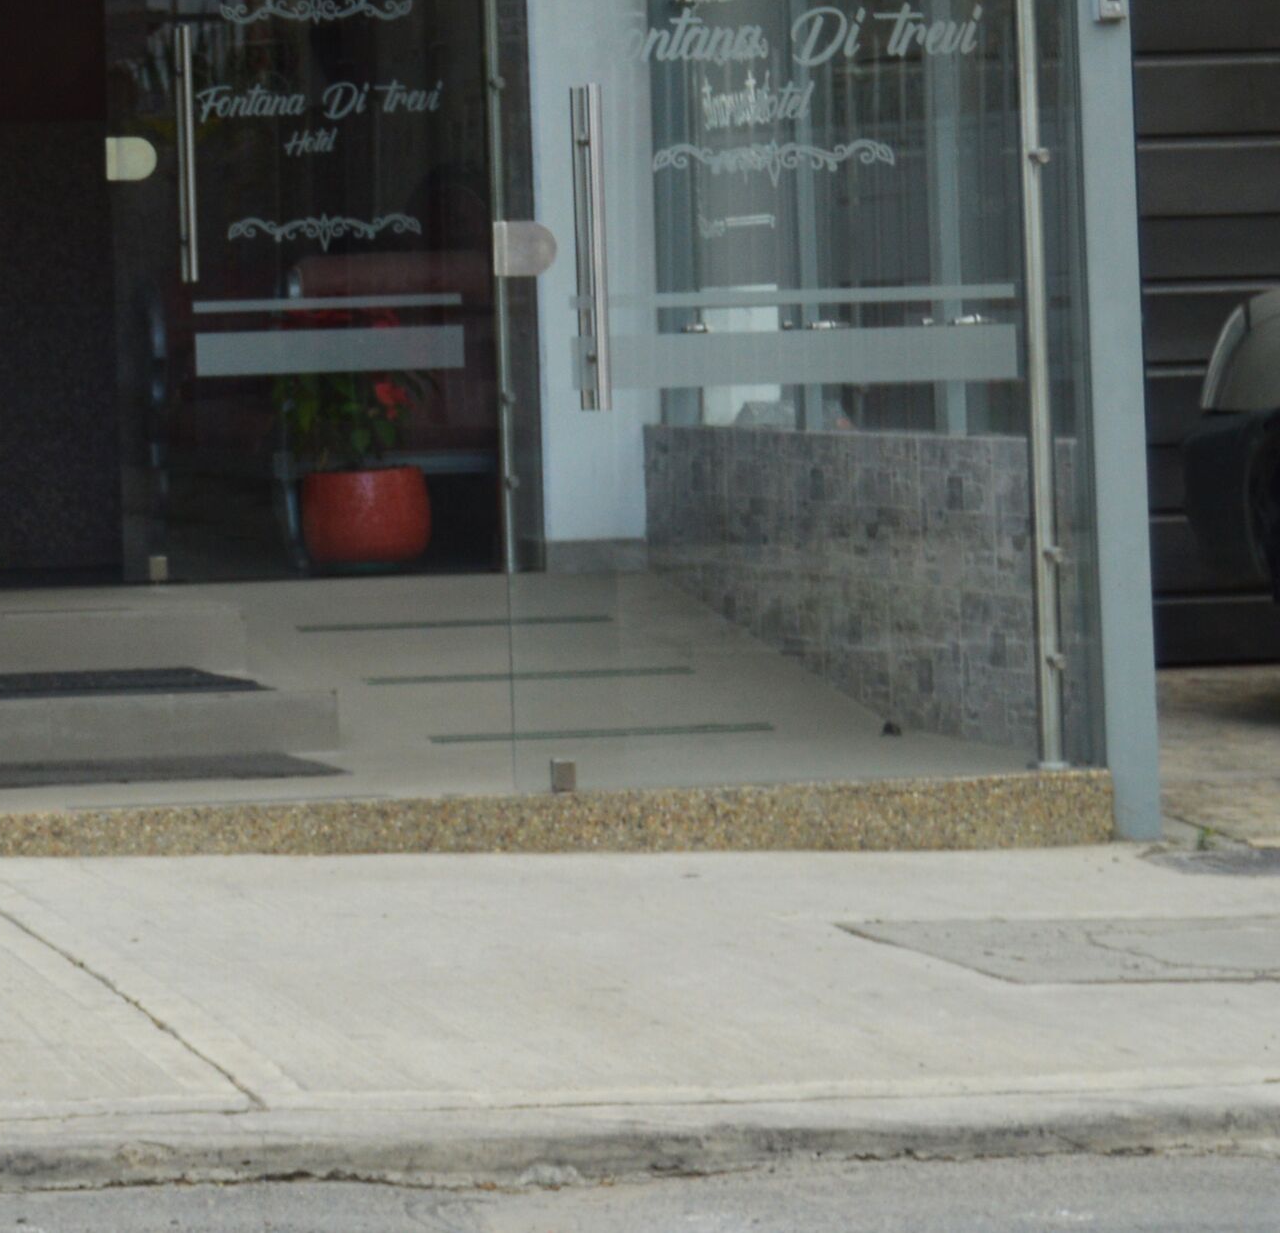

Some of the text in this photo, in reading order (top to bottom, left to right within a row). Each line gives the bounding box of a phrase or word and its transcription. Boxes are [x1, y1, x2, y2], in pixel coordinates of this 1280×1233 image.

[791, 6, 866, 67] Di
[196, 82, 306, 123] Fontana
[322, 81, 370, 121] Di
[284, 128, 338, 157] Hotel
